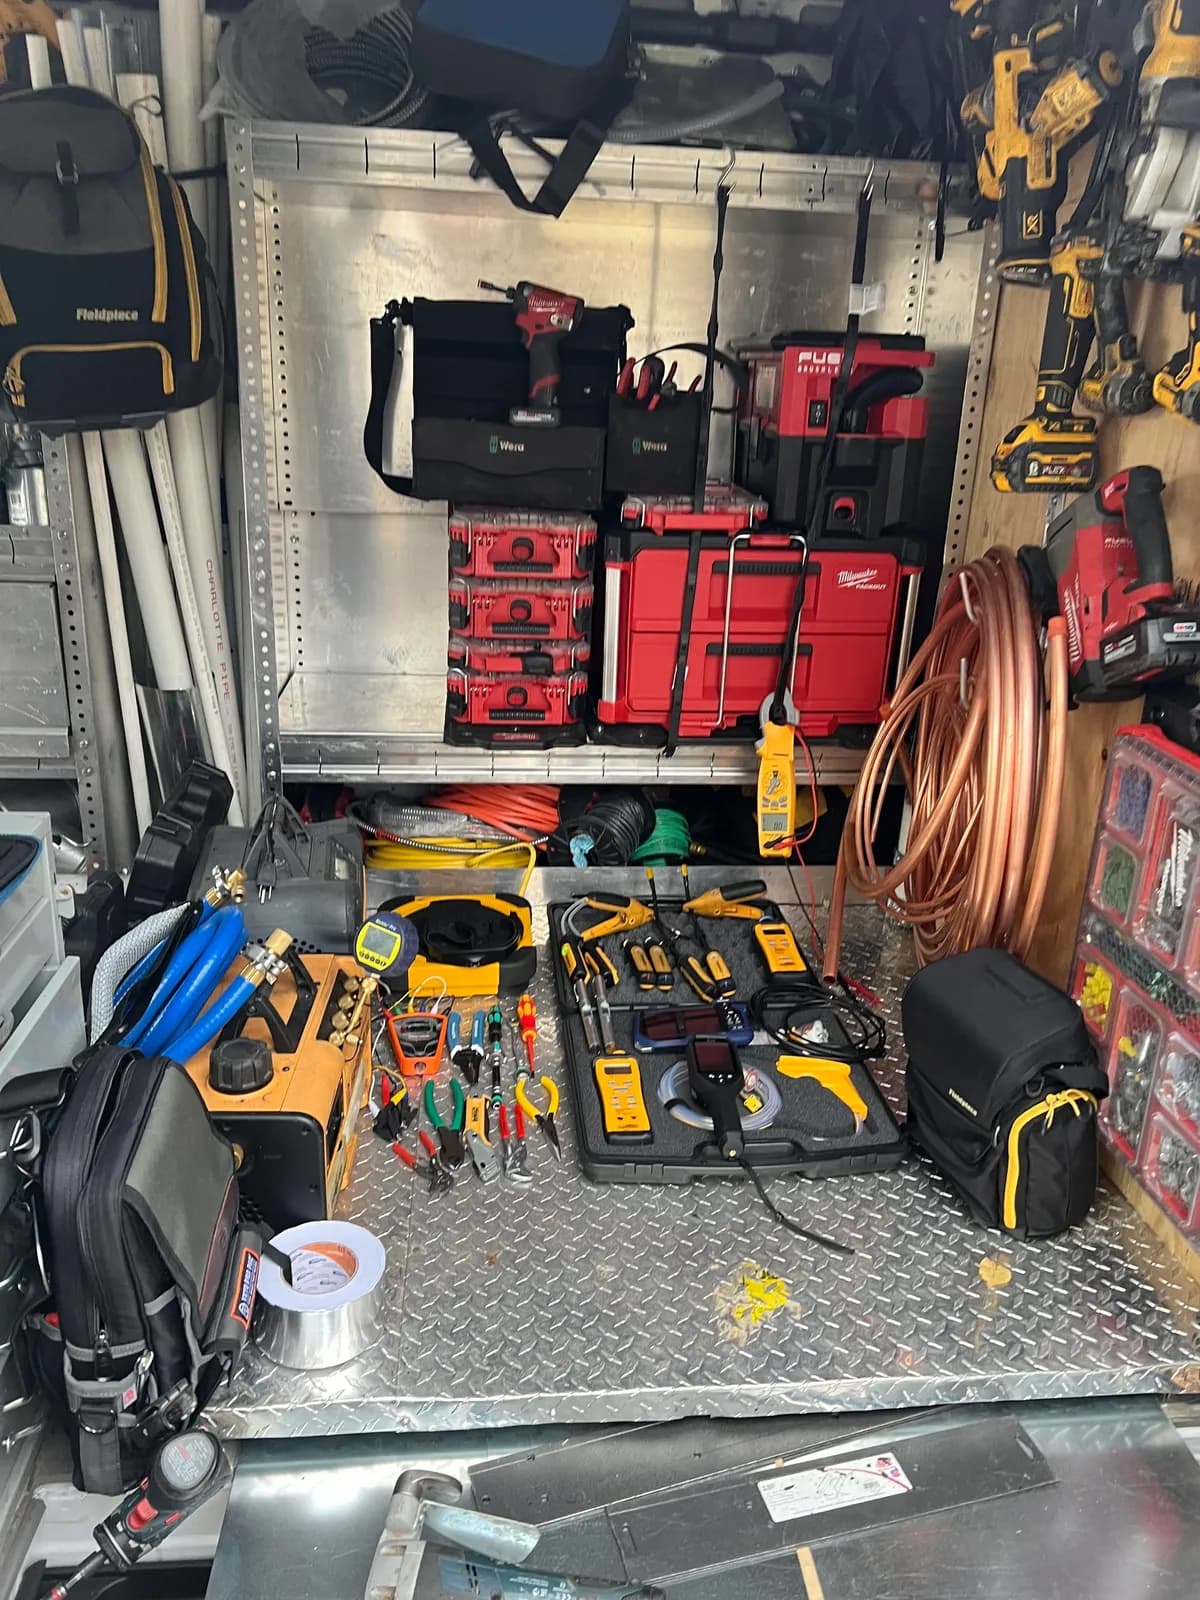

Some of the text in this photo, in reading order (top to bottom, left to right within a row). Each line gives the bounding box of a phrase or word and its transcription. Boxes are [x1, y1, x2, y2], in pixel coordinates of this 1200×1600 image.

[76, 307, 139, 323] Fieldpiece
[798, 351, 845, 364] FUE
[499, 439, 525, 453] Wera
[642, 440, 668, 453] Wera
[836, 567, 878, 585] Milwaukee
[205, 558, 224, 652] CHARLOTTE
[219, 662, 231, 701] PIPE
